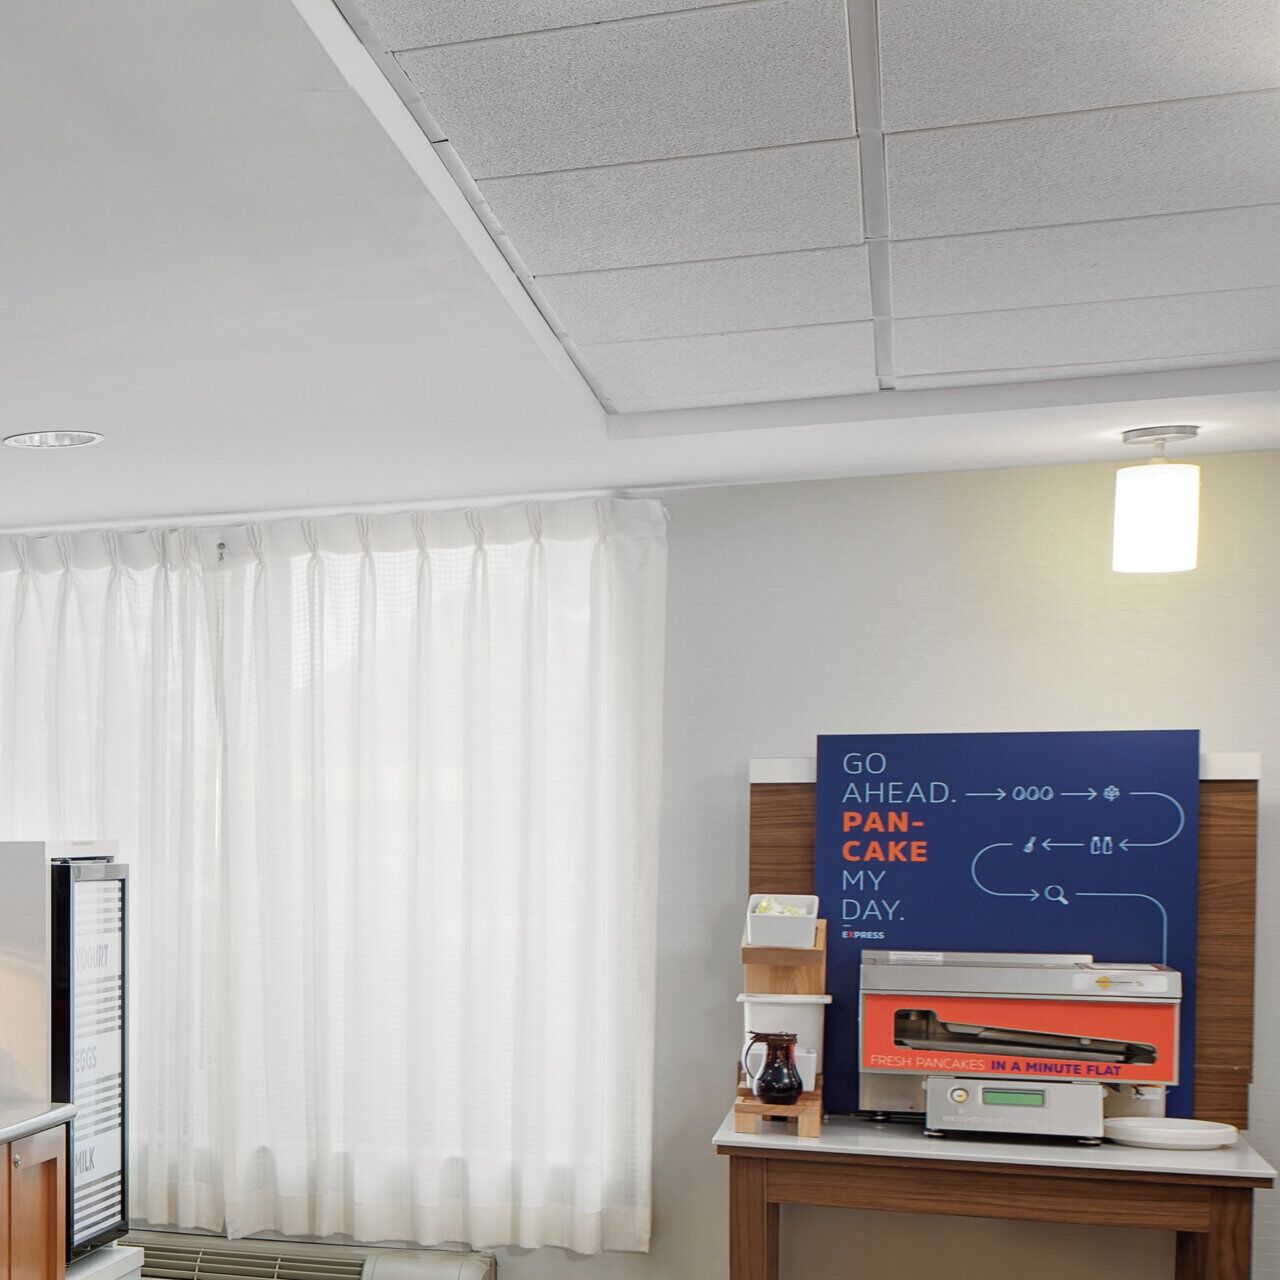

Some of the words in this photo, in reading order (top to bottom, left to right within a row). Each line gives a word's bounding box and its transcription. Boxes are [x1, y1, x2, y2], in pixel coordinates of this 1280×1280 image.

[842, 752, 887, 774] GO
[841, 782, 957, 803] AHEAD.
[842, 811, 925, 833] PAN-
[842, 840, 928, 862] CAKE
[842, 870, 887, 891] MY
[842, 899, 905, 921] DAY.
[841, 931, 885, 939] EXPRESS
[76, 944, 109, 970] YOGURT
[76, 1045, 97, 1073] EGGS
[870, 1055, 912, 1067] FRESH
[916, 1057, 985, 1071] PANCAKES
[991, 1060, 1007, 1071] IN
[1011, 1061, 1022, 1072] A
[1026, 1062, 1082, 1075] MINUTE
[1087, 1065, 1123, 1077] FLAT
[74, 1146, 95, 1176] MILK
